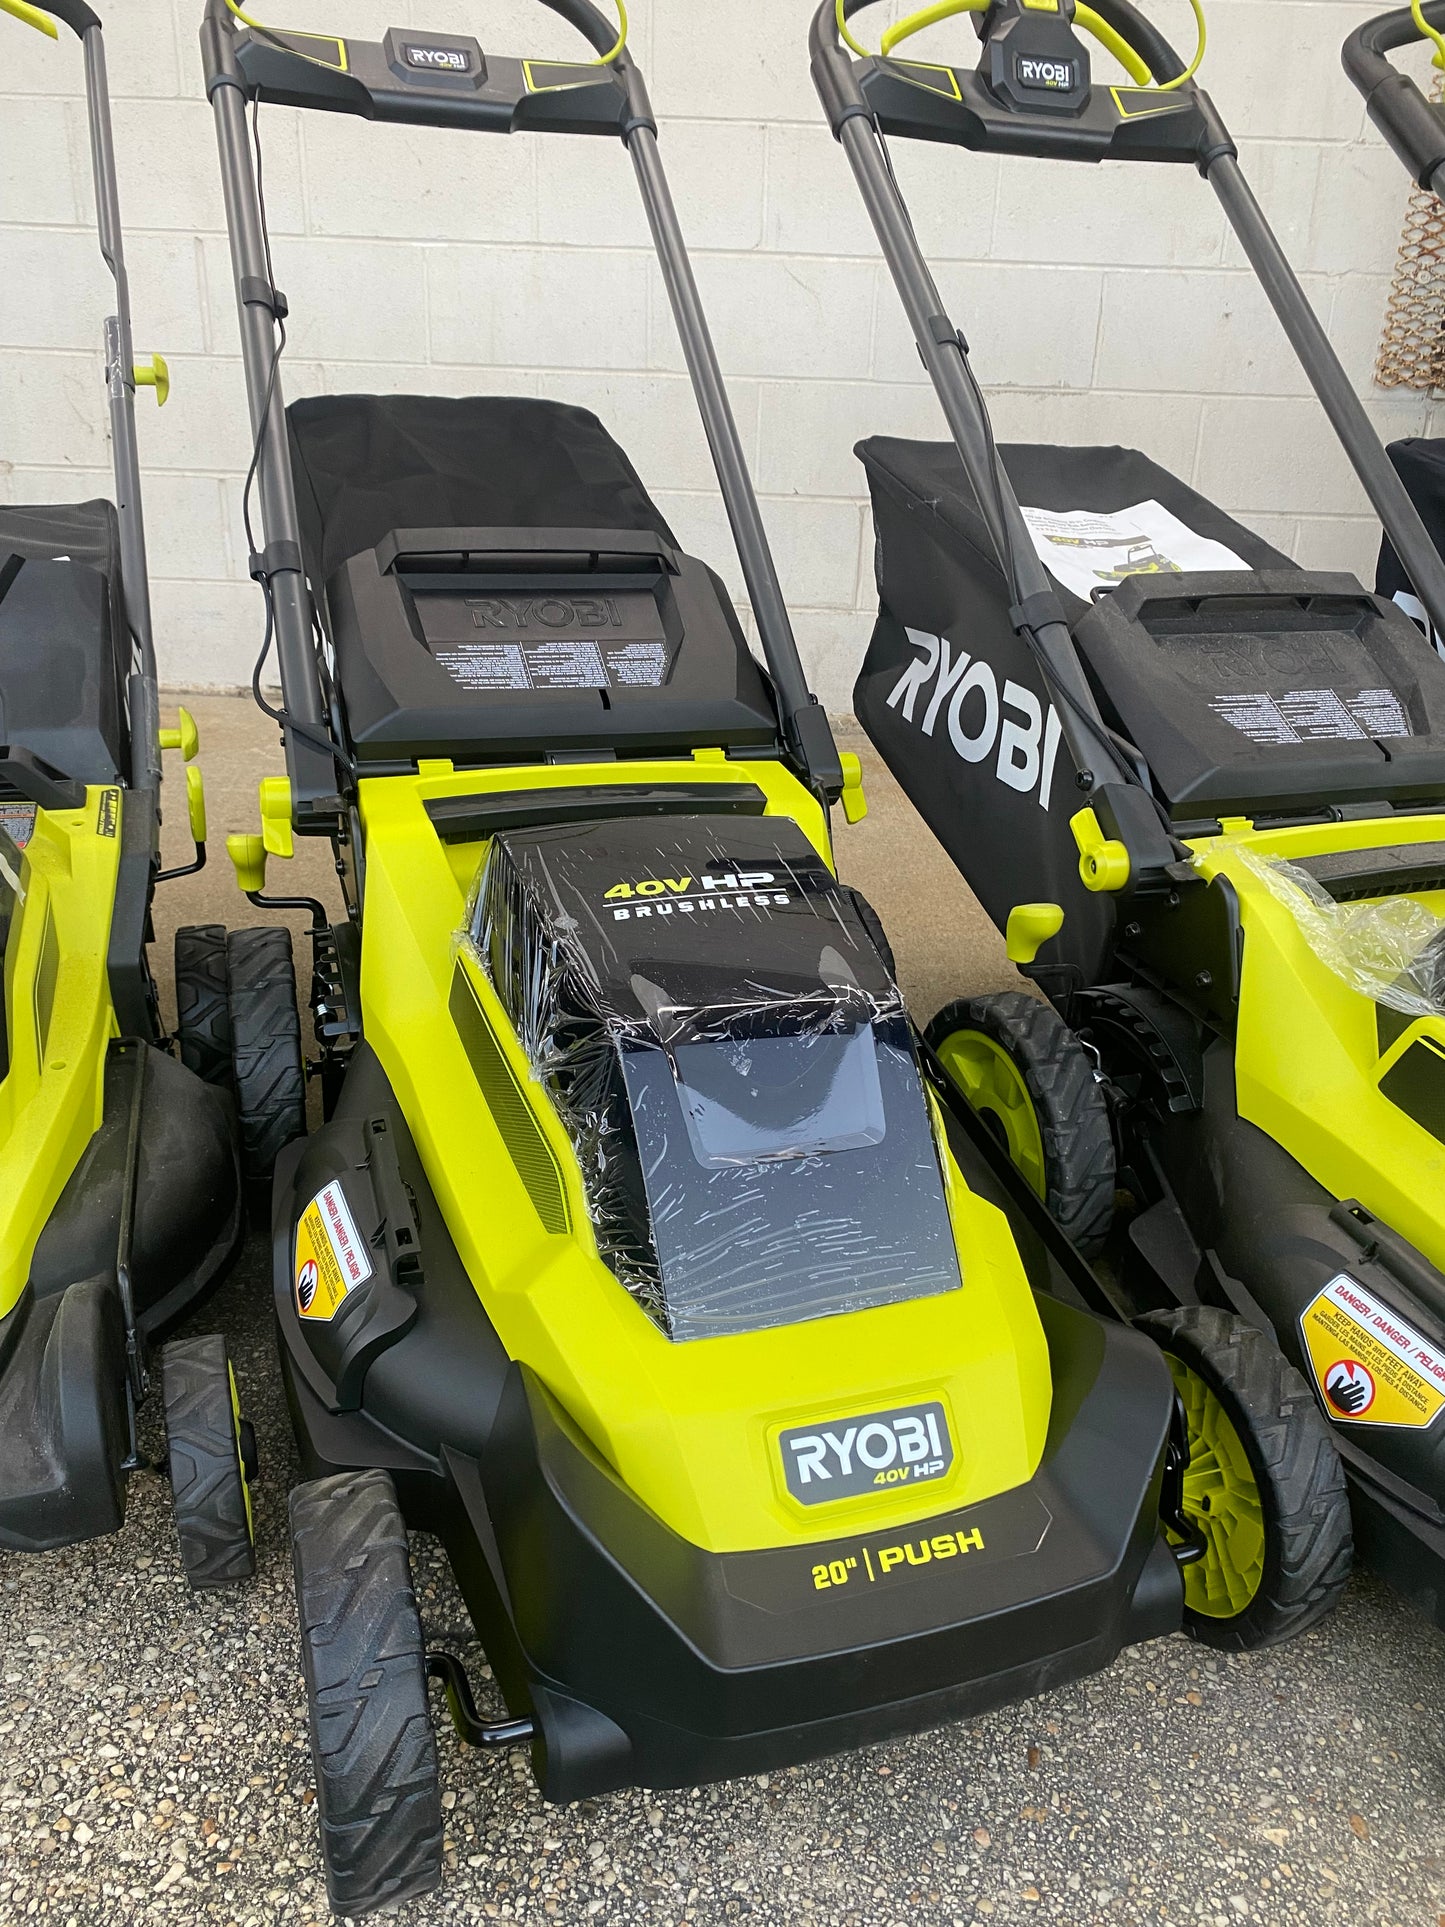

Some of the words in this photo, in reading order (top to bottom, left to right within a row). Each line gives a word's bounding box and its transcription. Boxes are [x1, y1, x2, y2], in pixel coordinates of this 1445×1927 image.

[411, 49, 465, 65] RYOBI
[1022, 60, 1069, 82] RYOBI
[464, 599, 623, 629] RYOBI
[886, 626, 1062, 811] RYOBI
[604, 876, 692, 899] 40V
[701, 872, 775, 890] HP
[613, 894, 791, 921] BRUSHLESS
[323, 1190, 338, 1220] DANGER
[333, 1218, 349, 1248] DANGER
[345, 1249, 361, 1280] PELIGRO
[1335, 1285, 1371, 1317] DANGER
[1372, 1315, 1411, 1350] DANGER
[1312, 1313, 1339, 1338] MANTENGA
[1338, 1335, 1350, 1347] LAS
[1349, 1345, 1369, 1363] MANOS
[1371, 1363, 1383, 1375] LOS
[1381, 1372, 1396, 1386] PIES
[1398, 1387, 1428, 1414] DISTANCIA
[1319, 1310, 1341, 1330] GARDER
[1339, 1327, 1350, 1338] LES
[1371, 1354, 1382, 1365] LES
[1381, 1362, 1398, 1378] PIEDS
[1401, 1380, 1429, 1405] DISTANCE
[1334, 1312, 1352, 1327] KEEP
[1350, 1326, 1374, 1347] HANDS
[1372, 1345, 1387, 1359] and
[1385, 1355, 1404, 1371] FEET
[1402, 1370, 1425, 1389] AWAY
[789, 1413, 943, 1484] RYOBI
[873, 1466, 910, 1485] 40V
[914, 1459, 945, 1478] HP
[811, 1556, 858, 1590] 20"
[878, 1527, 985, 1573] PUSH
